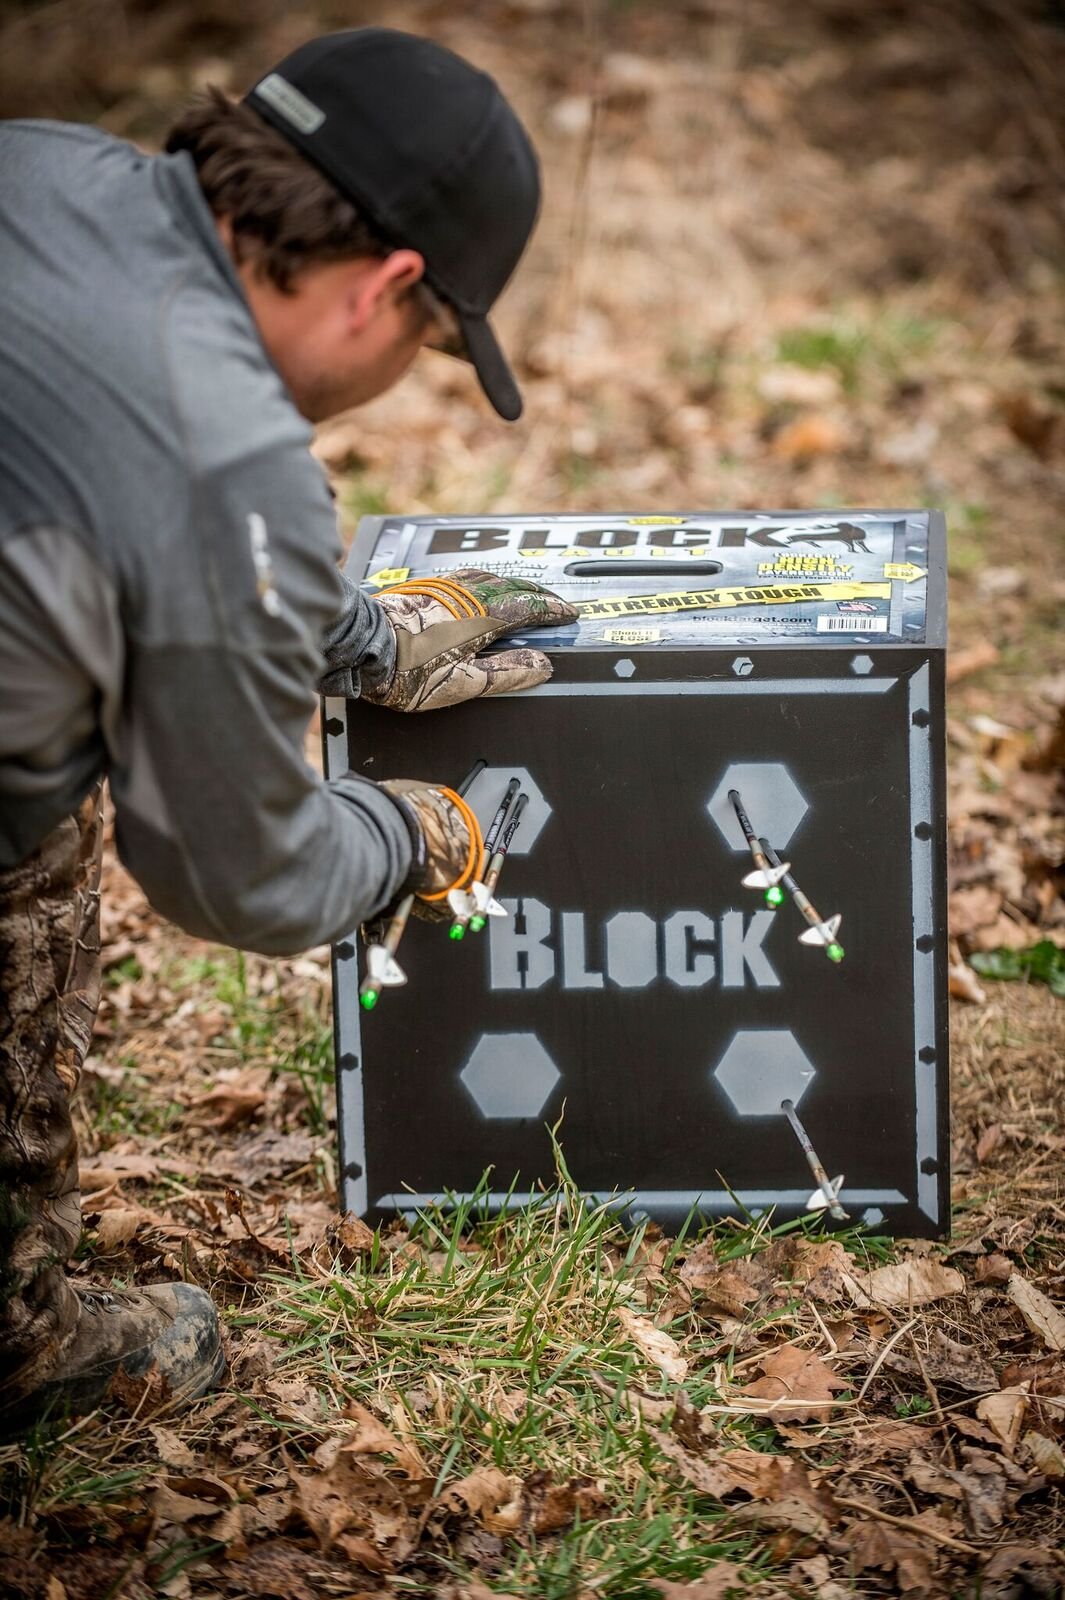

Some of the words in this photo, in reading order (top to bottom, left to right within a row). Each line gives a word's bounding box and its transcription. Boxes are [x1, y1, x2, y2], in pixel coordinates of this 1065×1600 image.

[426, 527, 790, 554] BLOCK
[518, 548, 712, 557] VAULT
[779, 557, 835, 565] HIGH
[758, 563, 854, 572] DENSITY
[580, 592, 721, 615] EXTREMELY
[727, 587, 823, 601] TOUGH
[489, 897, 781, 989] BLOCK
